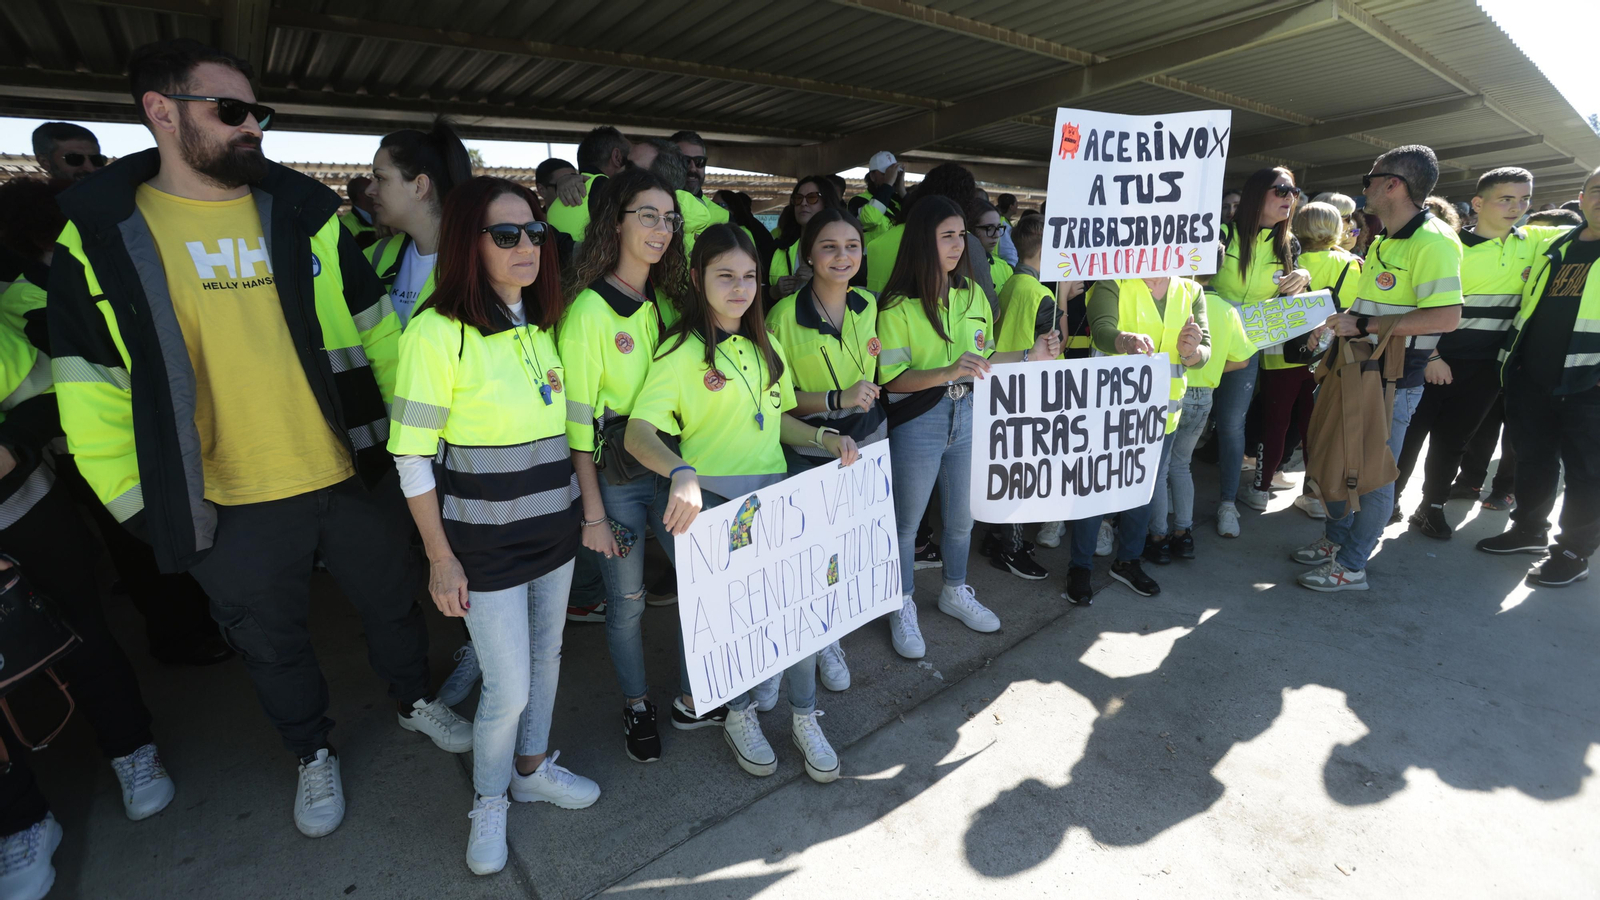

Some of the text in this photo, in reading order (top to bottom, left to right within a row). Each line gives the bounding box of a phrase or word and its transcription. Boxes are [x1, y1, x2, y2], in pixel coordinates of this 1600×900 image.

[1088, 171, 1184, 206] A TUS
[1048, 212, 1214, 249] TRABAJADORES
[1071, 245, 1185, 276] VALORALOS
[202, 277, 275, 290] HELLY HANS
[990, 365, 1153, 416] NI UN PASO
[1104, 405, 1168, 451] HEMOS
[986, 458, 1052, 501] DADO
[690, 454, 890, 584] NO NOS VAMOS
[692, 514, 891, 653] A RENDIR TODOS
[700, 558, 900, 704] JUNTOS HASTA EL FIN
